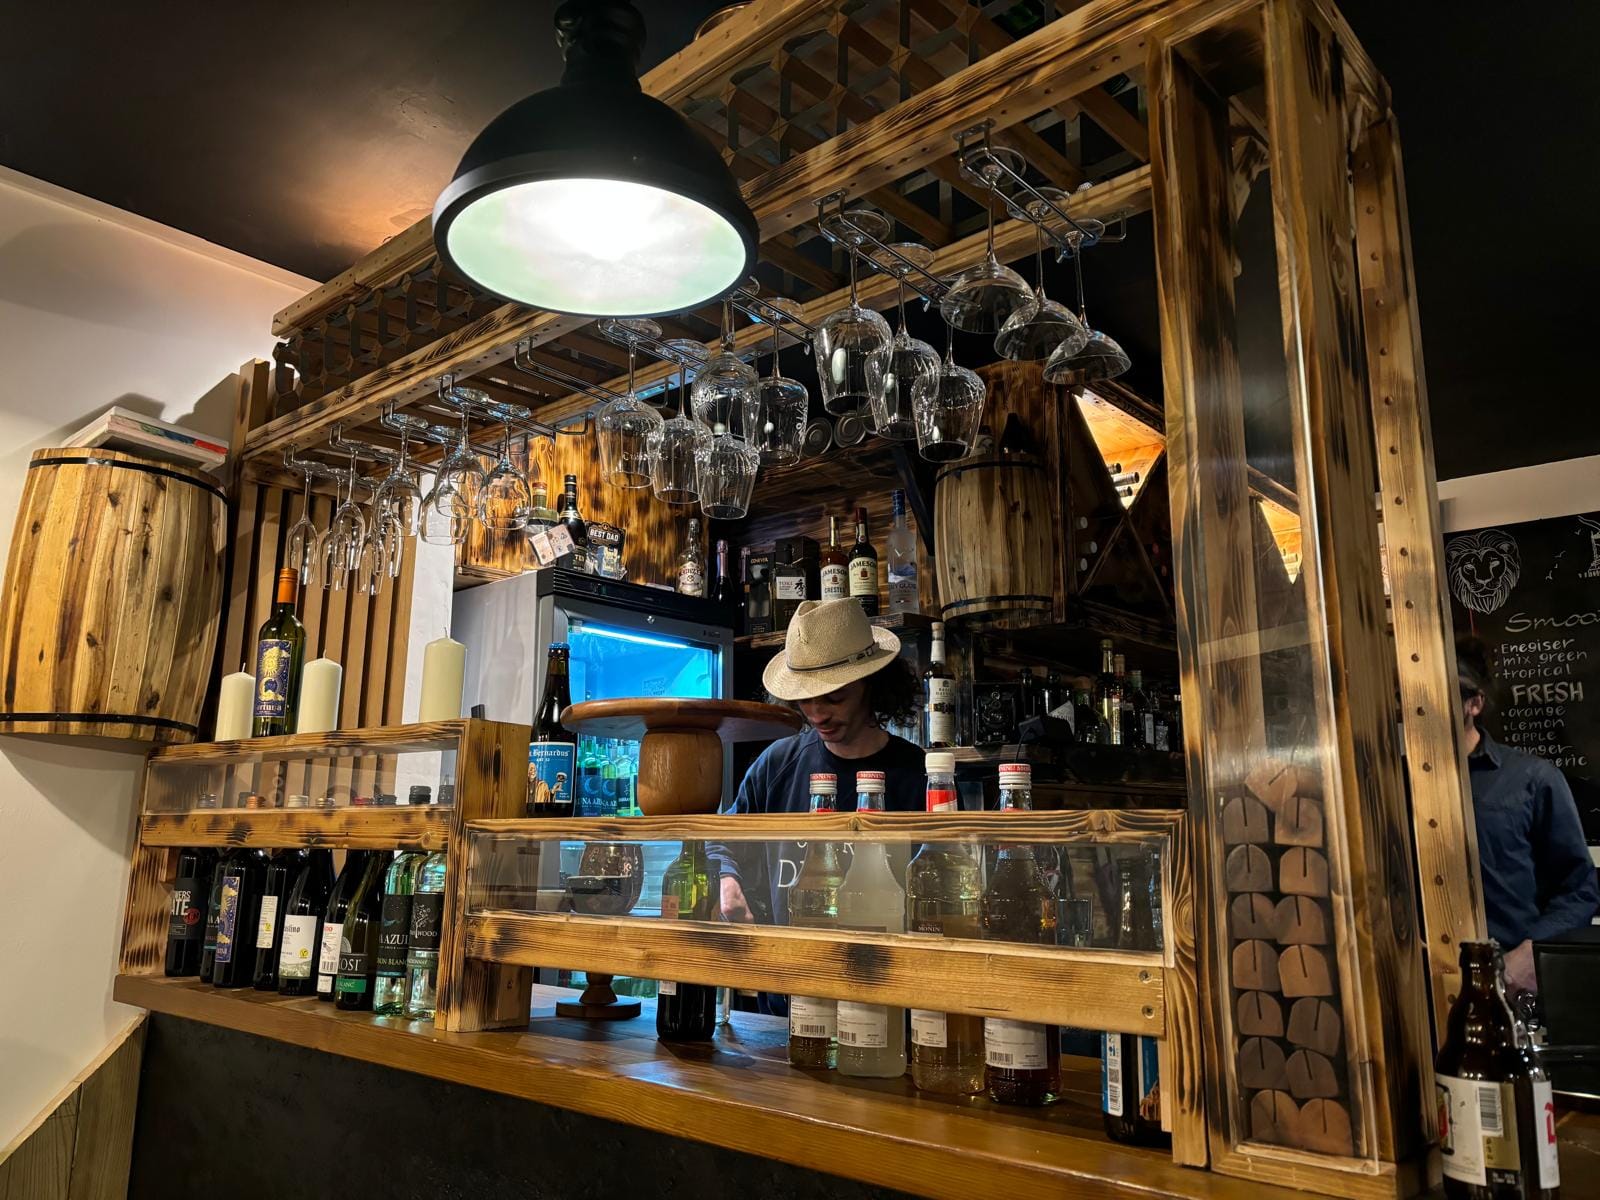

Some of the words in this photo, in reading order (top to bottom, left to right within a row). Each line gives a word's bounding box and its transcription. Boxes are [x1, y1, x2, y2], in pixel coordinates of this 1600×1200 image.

[589, 528, 605, 539] BEST
[606, 532, 619, 542] DAD
[1503, 653, 1532, 667] mix
[1539, 650, 1588, 664] green
[1502, 663, 1572, 679] tropical
[1511, 680, 1585, 706] FRESH
[1508, 705, 1567, 718] orange
